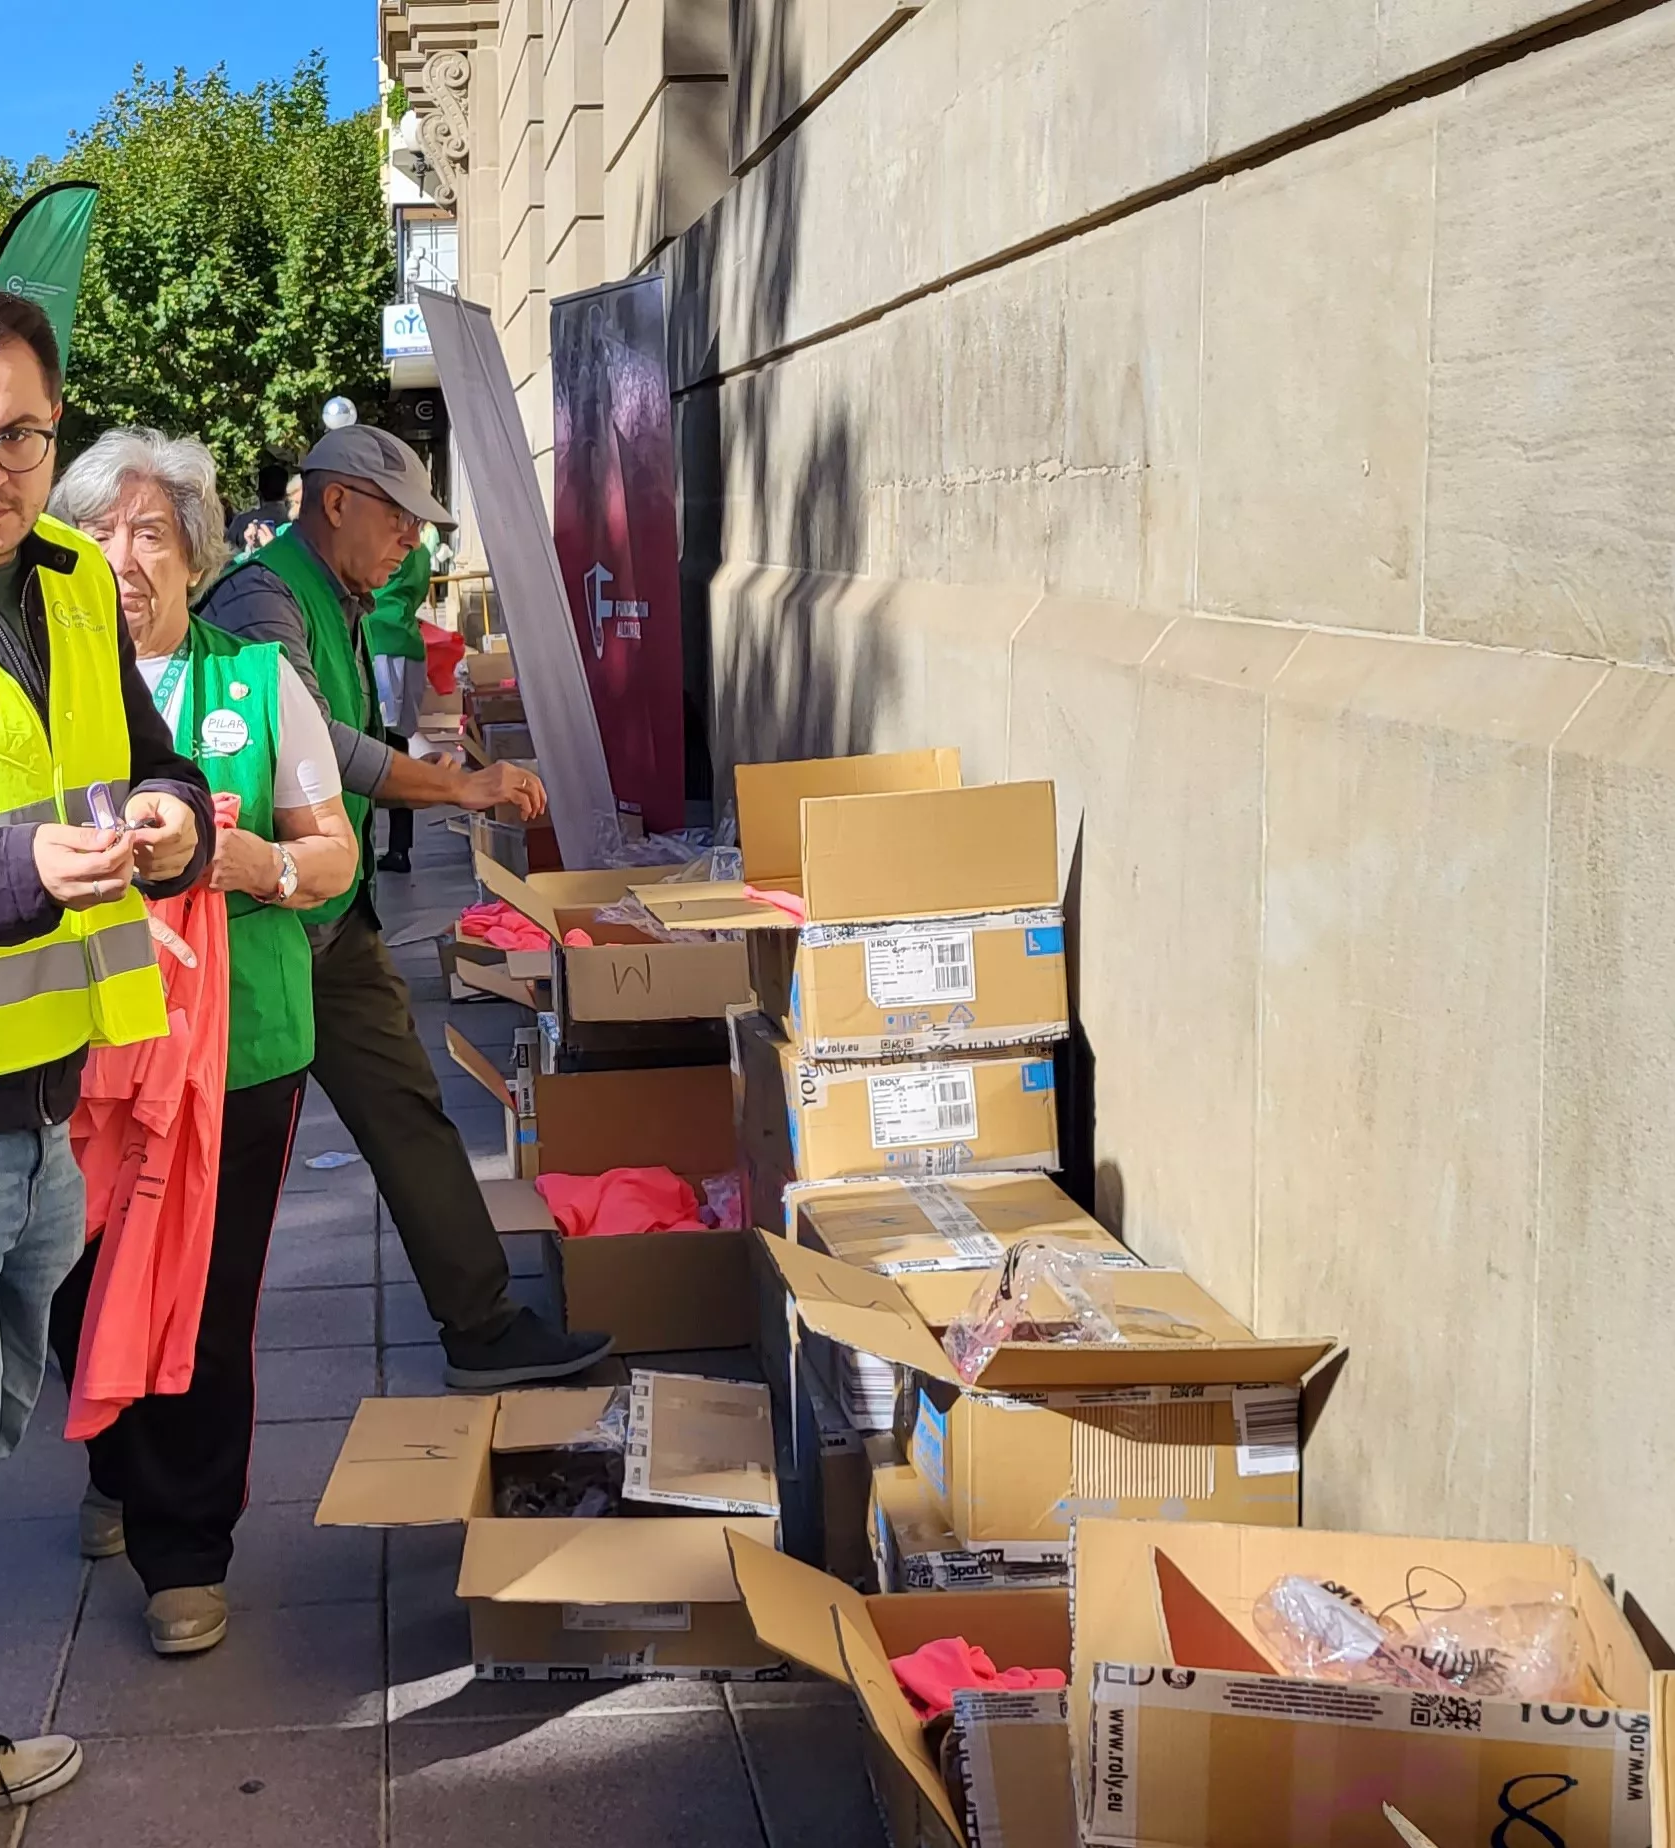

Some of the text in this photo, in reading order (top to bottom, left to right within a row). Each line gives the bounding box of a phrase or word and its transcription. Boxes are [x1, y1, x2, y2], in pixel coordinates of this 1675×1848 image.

[208, 717, 245, 730] PILAR
[877, 939, 898, 948] ROLY
[879, 1078, 900, 1087] ROLY
[1024, 1069, 1037, 1088] L
[1103, 1708, 1129, 1813] www.roly.eu
